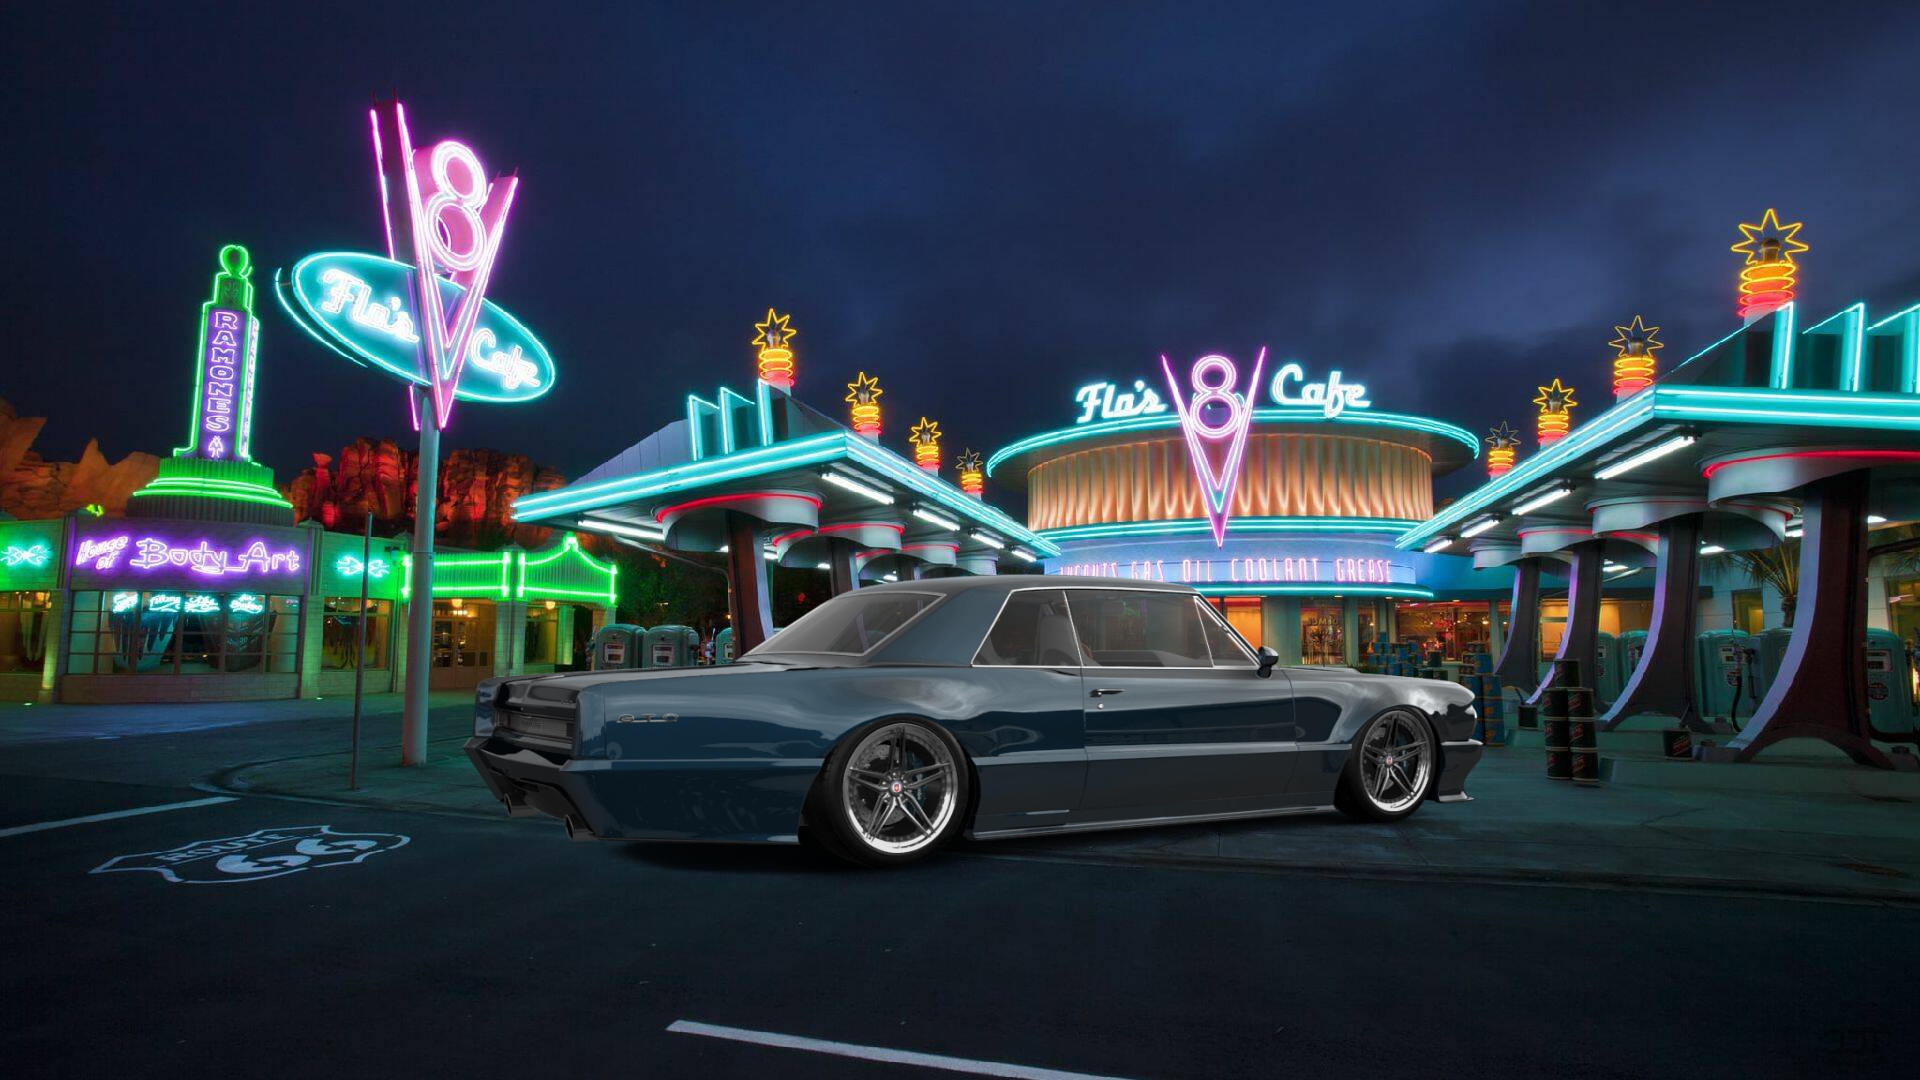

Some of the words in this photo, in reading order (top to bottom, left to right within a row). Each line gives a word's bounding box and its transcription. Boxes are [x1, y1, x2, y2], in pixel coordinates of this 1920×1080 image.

[321, 268, 420, 343] Flo's
[470, 327, 541, 390] Cafe
[205, 311, 238, 432] RAMONES
[1075, 379, 1169, 424] Flo's
[1271, 363, 1371, 418] Cafe
[75, 537, 129, 565] House
[95, 550, 118, 570] of
[130, 538, 226, 574] Body
[237, 541, 300, 573] Art
[1131, 560, 1165, 582] GAS
[1182, 559, 1213, 582] OIL
[1231, 557, 1320, 583] COOLANT
[1335, 558, 1393, 583] GREASE
[617, 713, 679, 723] GTO
[154, 833, 294, 862] ROUTE
